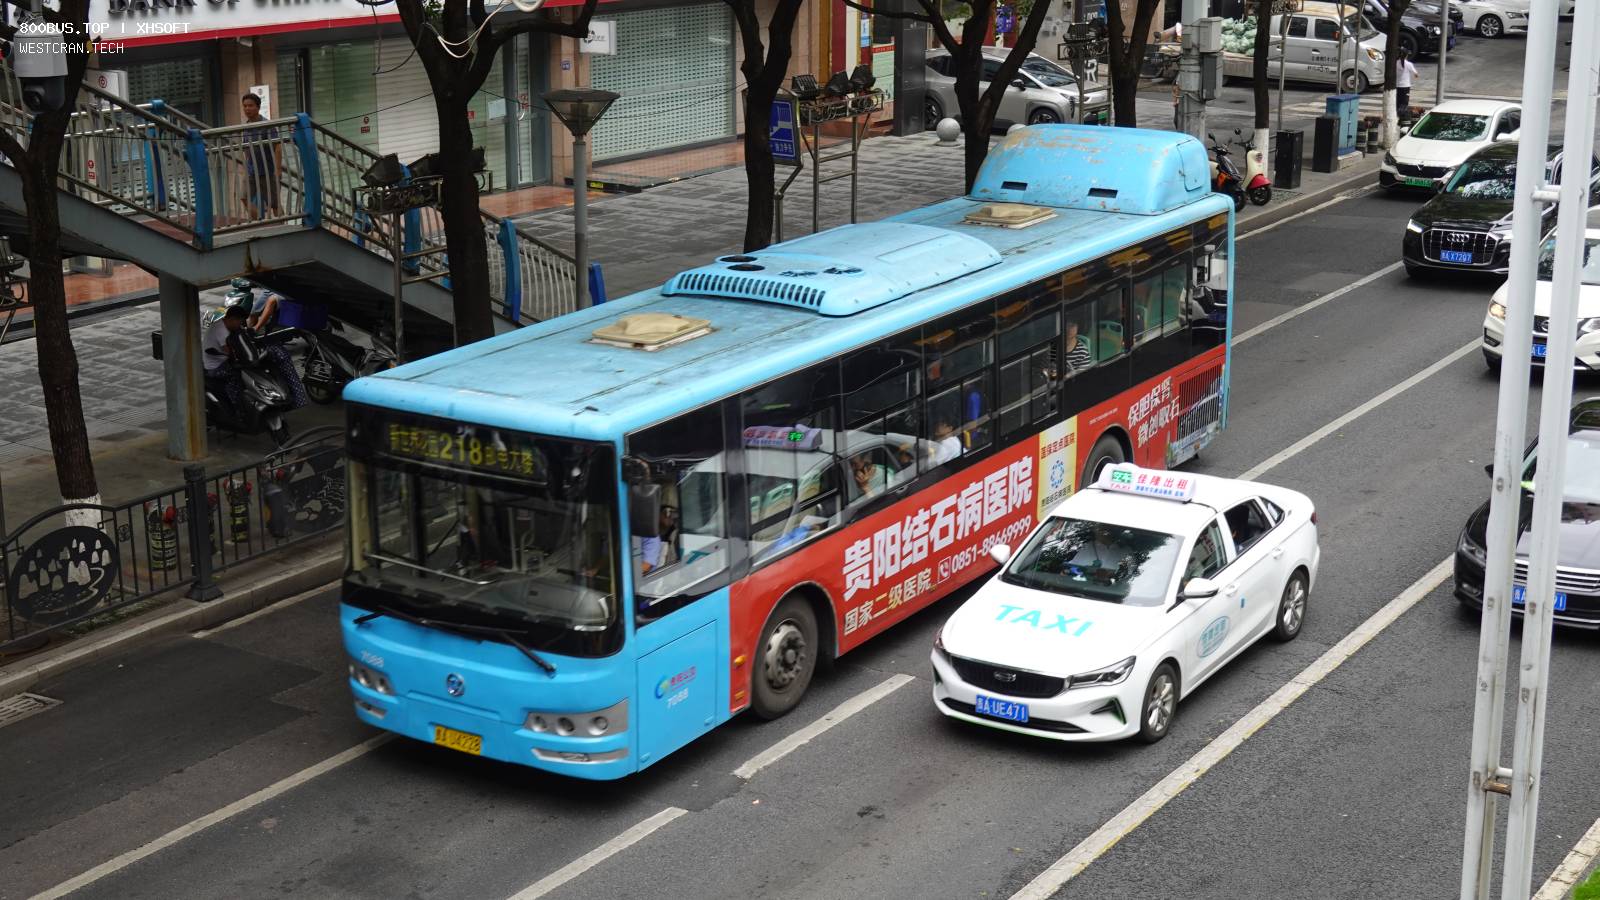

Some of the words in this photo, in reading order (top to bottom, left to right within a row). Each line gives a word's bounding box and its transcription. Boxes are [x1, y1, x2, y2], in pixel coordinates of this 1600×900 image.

[1127, 376, 1172, 430] 保胆保肾
[439, 433, 482, 465] 218
[842, 455, 1033, 602] 贵阳结石病医院
[951, 514, 1032, 574] 0851-88669999
[844, 567, 932, 637] 国家二级医院
[995, 604, 1094, 637] TAXI
